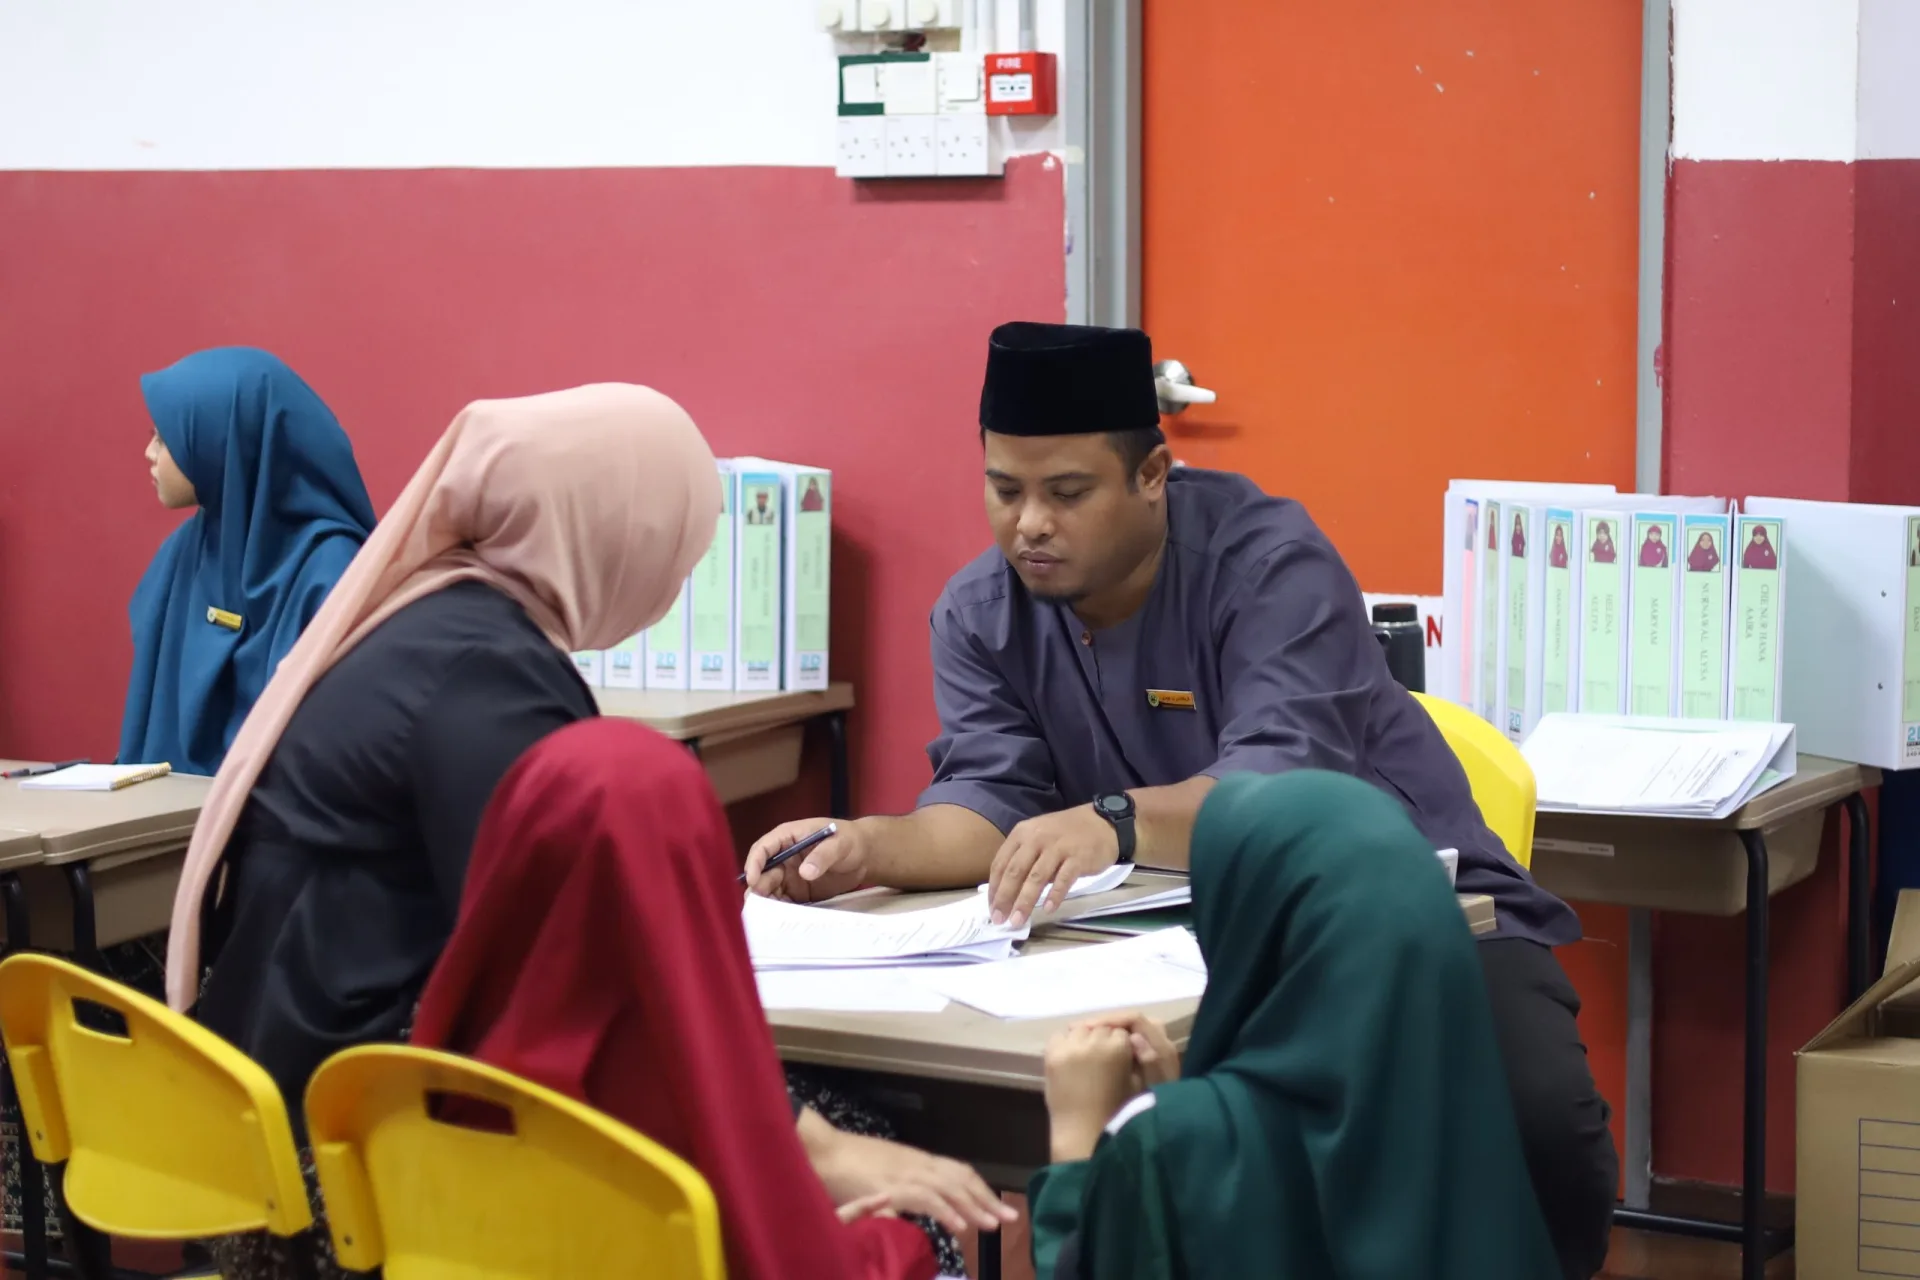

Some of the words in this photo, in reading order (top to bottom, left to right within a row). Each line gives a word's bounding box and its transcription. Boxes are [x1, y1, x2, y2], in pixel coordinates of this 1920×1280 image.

[996, 57, 1022, 69] FIRE
[1760, 584, 1770, 605] CHE
[1605, 594, 1614, 635] HELENA
[1650, 596, 1659, 646] MARYAM
[1759, 607, 1769, 630] NUR
[1758, 632, 1767, 663] HANA
